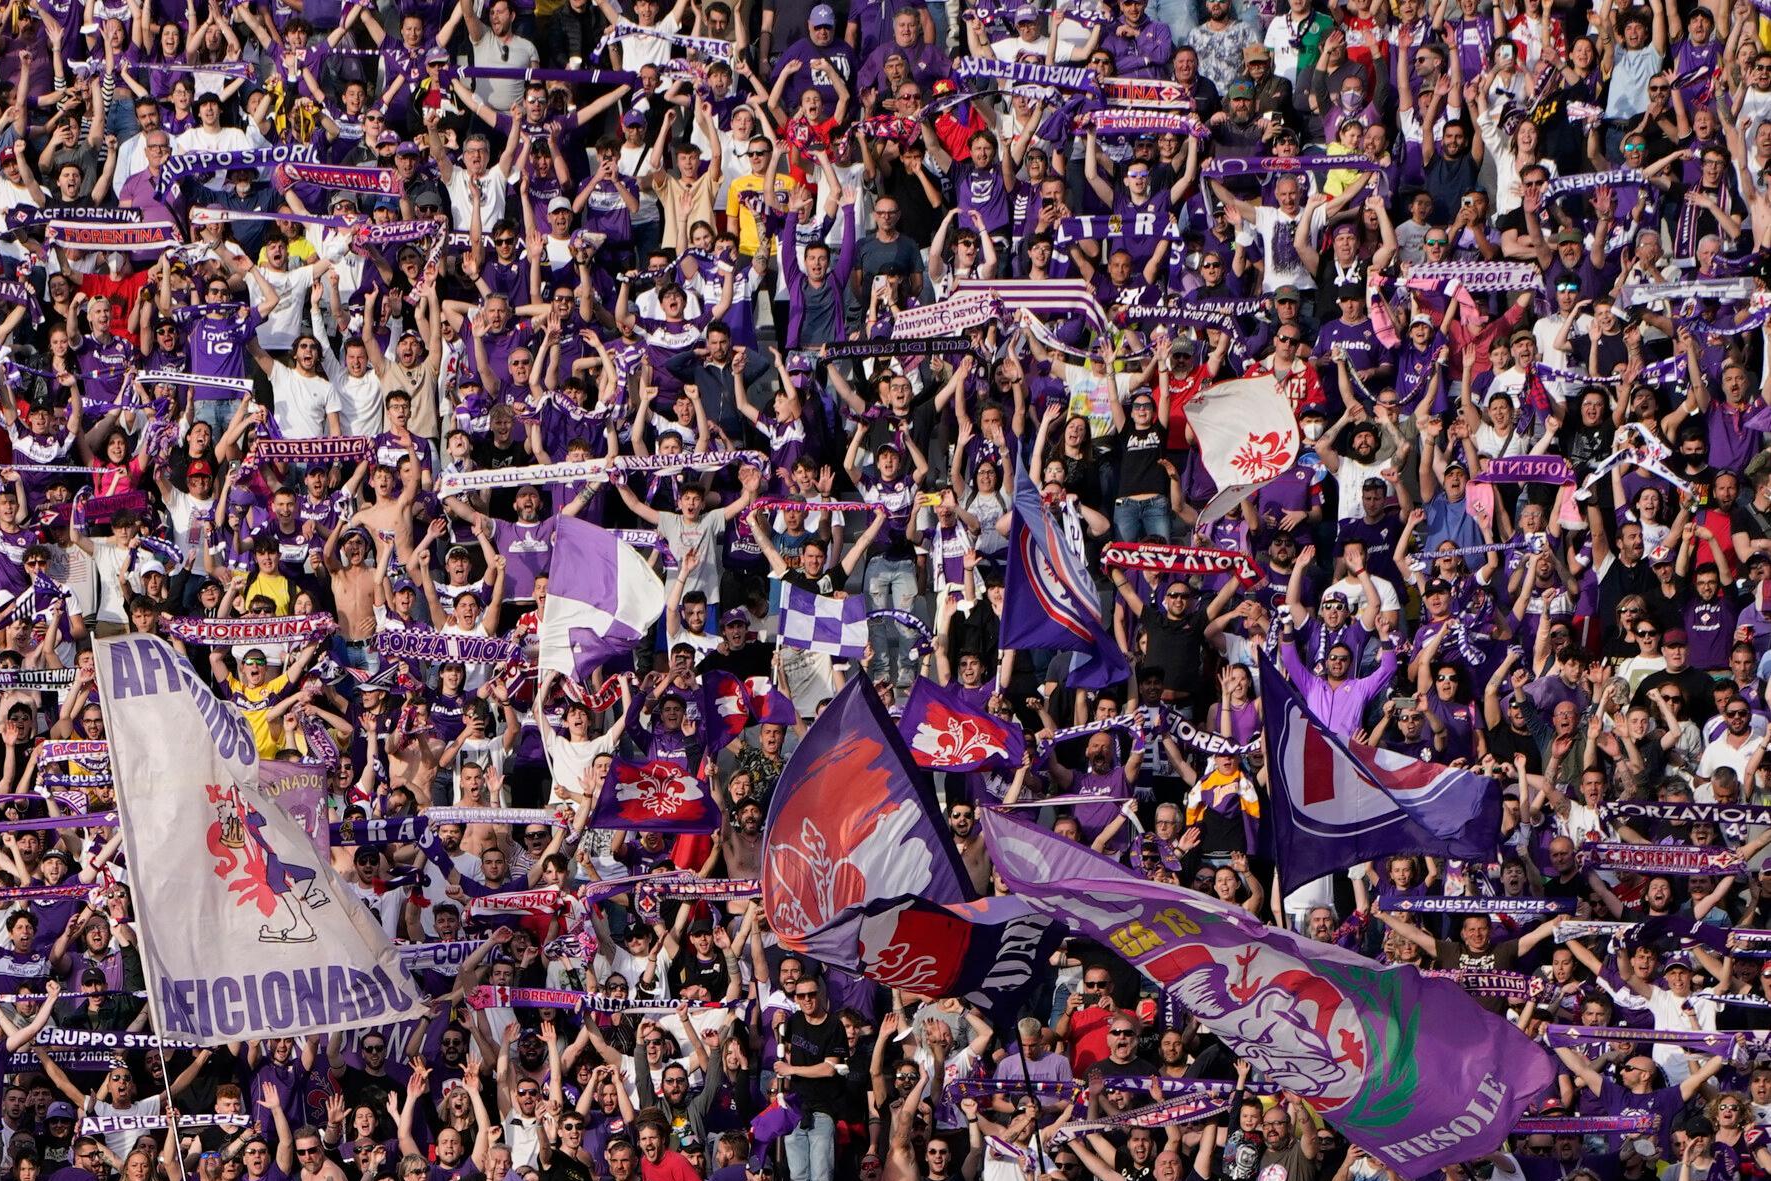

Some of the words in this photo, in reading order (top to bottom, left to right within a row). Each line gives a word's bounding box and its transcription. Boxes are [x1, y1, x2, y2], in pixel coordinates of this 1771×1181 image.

[956, 56, 1088, 89] IMBULLETTAT
[1104, 83, 1159, 99] NTINA
[1541, 170, 1623, 199] FIORENTI
[34, 207, 61, 221] ACF
[63, 207, 142, 223] FIORENTINA
[63, 227, 166, 244] FIORENTINA
[259, 441, 364, 456] FIORENTINA
[196, 619, 313, 641] FIORENTINA
[378, 632, 448, 657] FORZA
[456, 635, 524, 662] VIOLA
[17, 668, 80, 683] TOTTENHA
[1462, 976, 1525, 991] RENTINA
[510, 988, 579, 1006] FIORENTIN
[37, 1025, 118, 1048] GRUPPO
[80, 1113, 251, 1135] AFICIOADOS
[1379, 1070, 1509, 1165] FIESOLE
